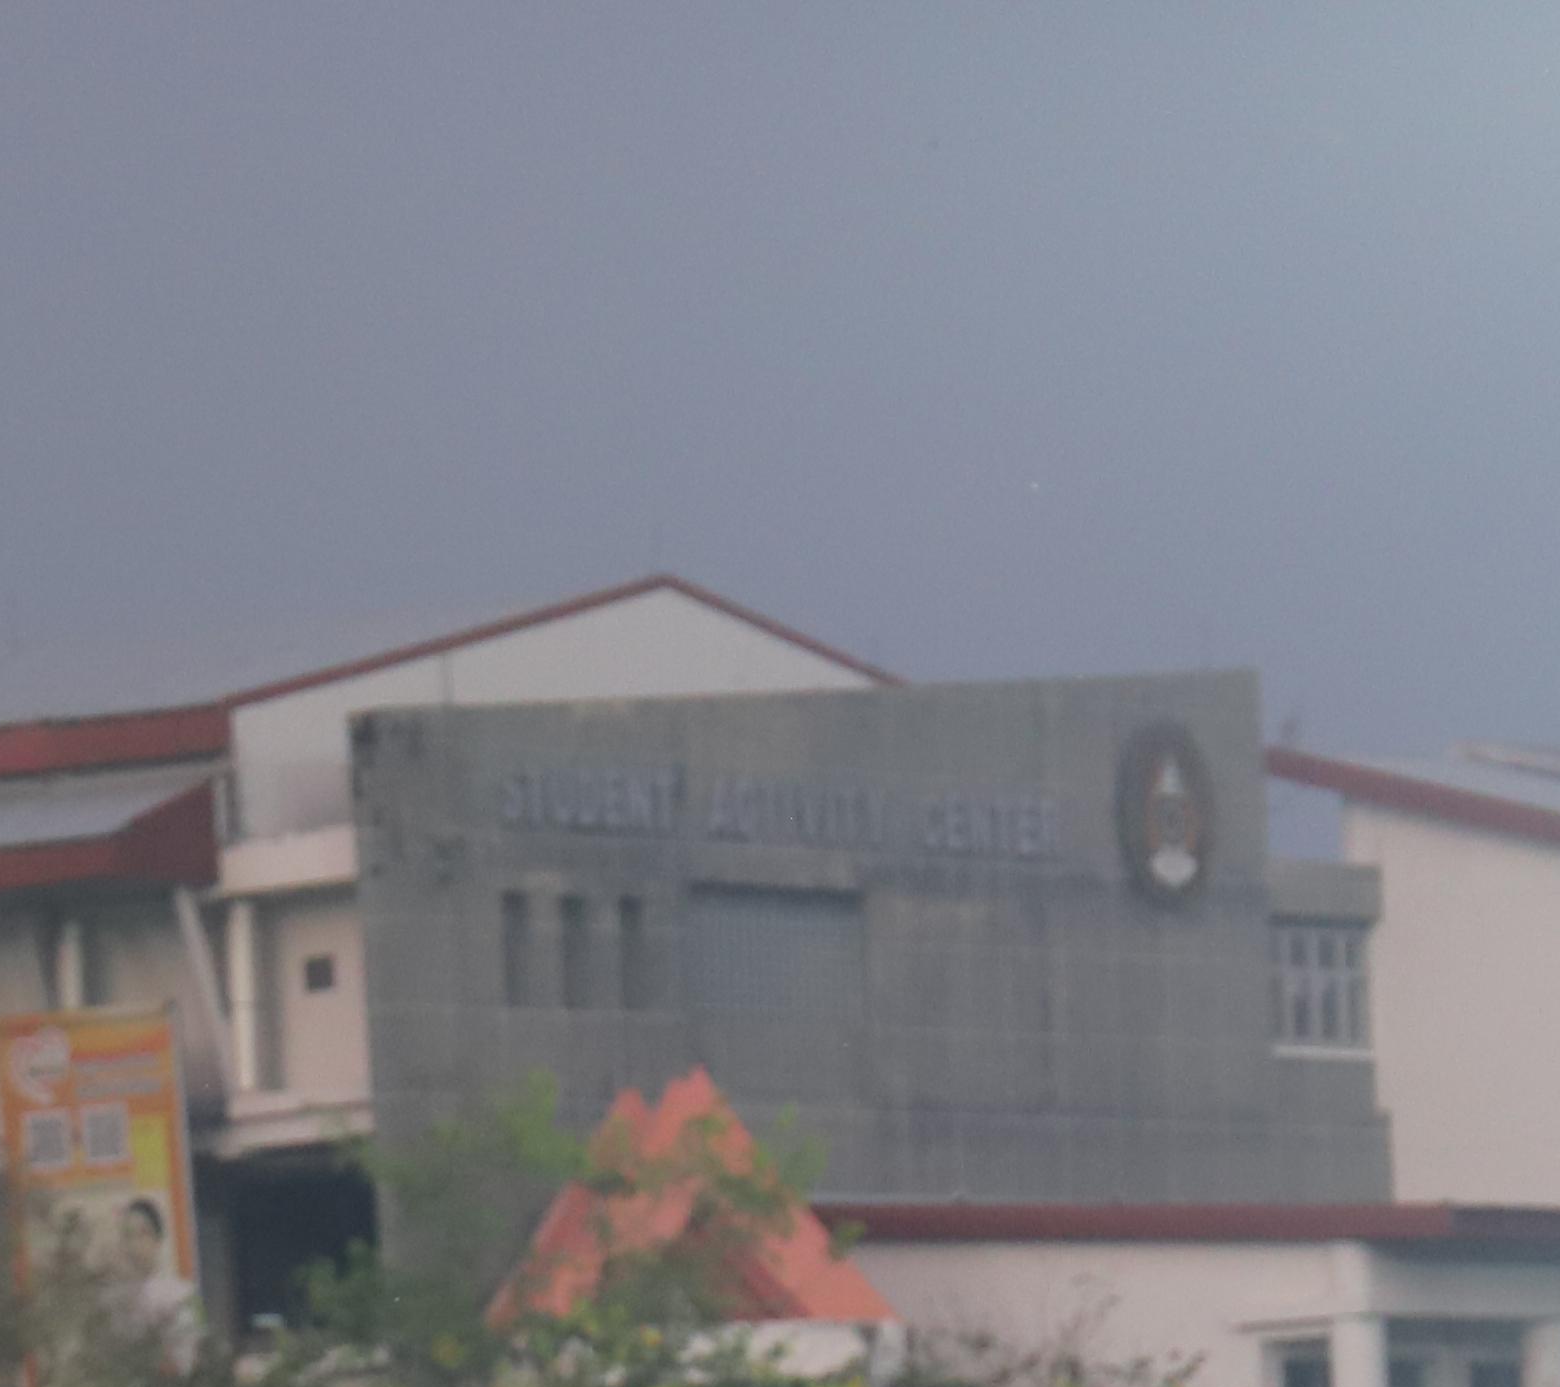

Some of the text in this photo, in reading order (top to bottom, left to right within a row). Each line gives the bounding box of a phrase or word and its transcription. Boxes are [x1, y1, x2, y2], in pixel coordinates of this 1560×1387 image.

[500, 768, 1063, 858] STUDENT ACTIVITY CENTER
